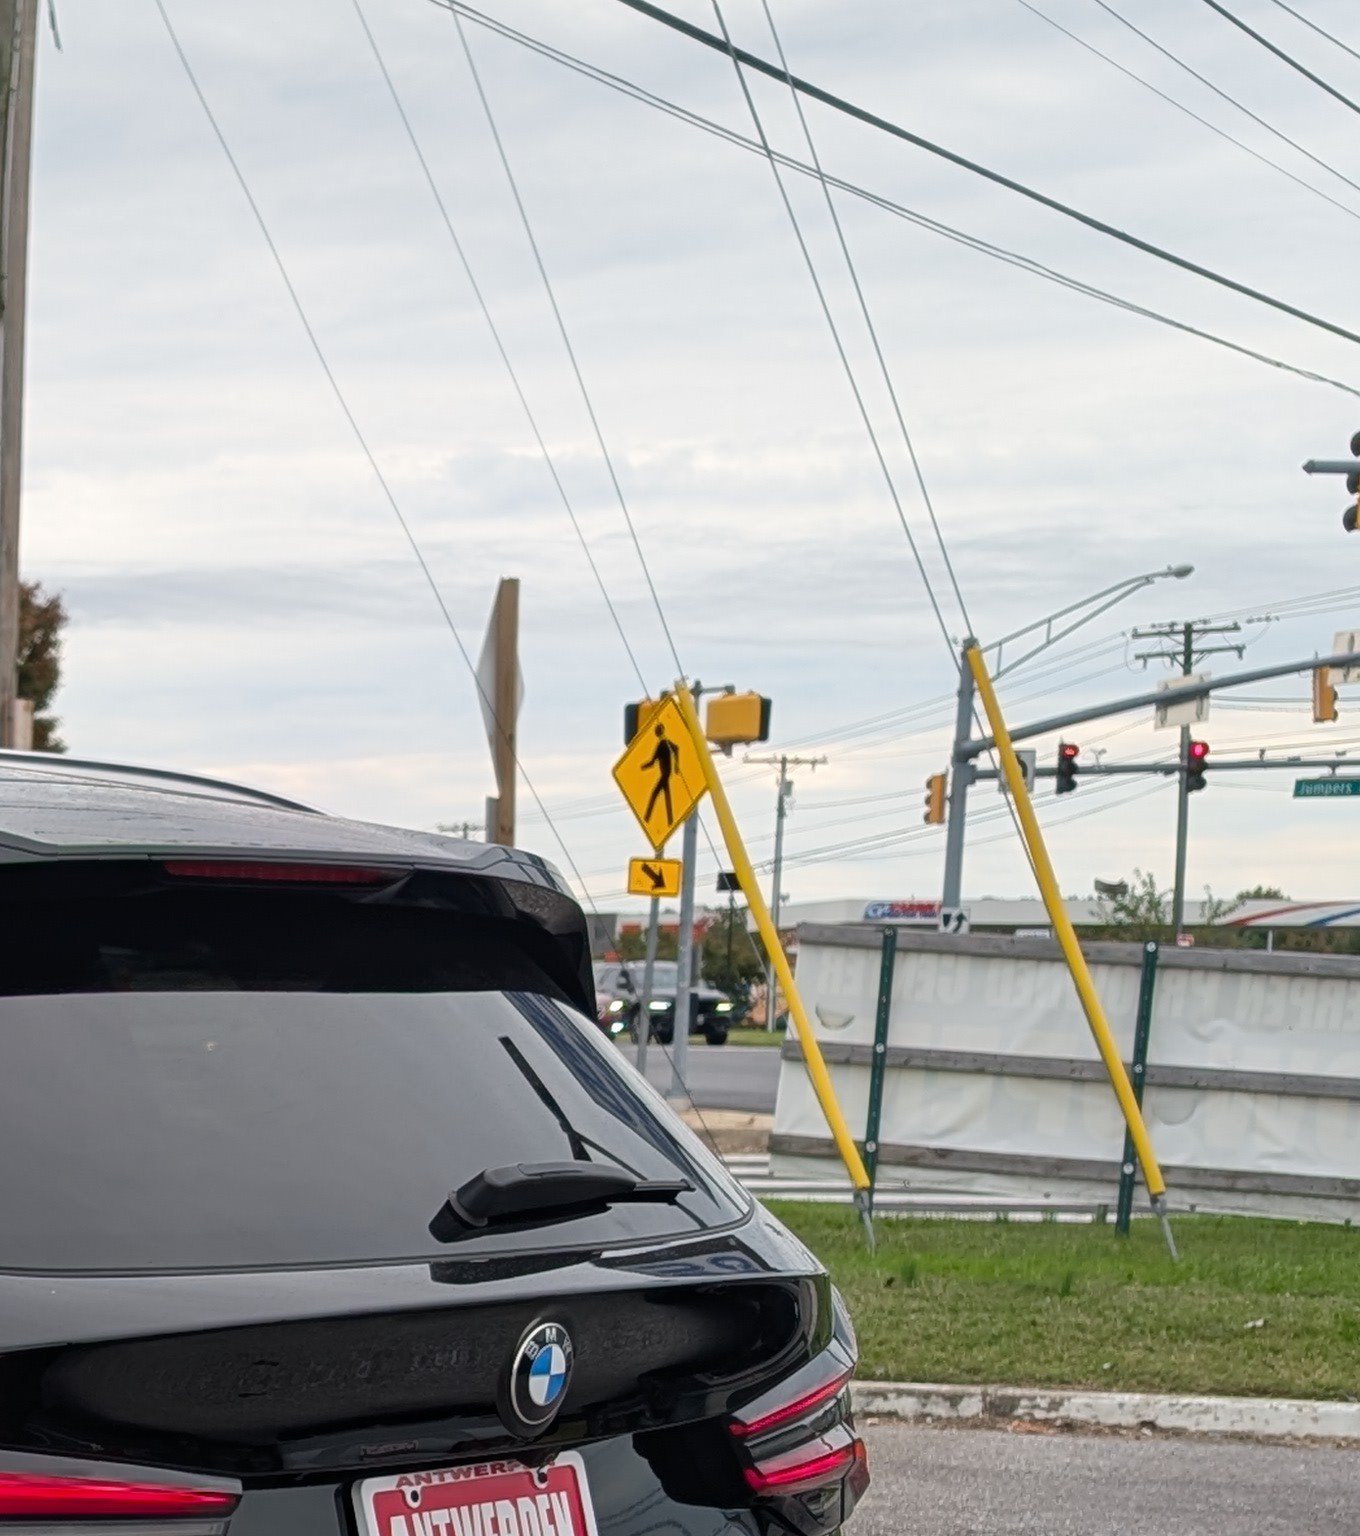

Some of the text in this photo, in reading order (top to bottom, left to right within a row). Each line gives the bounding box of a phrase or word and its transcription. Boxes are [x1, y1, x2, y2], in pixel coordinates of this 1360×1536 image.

[1299, 782, 1353, 795] Jumpers
[524, 1327, 573, 1360] BMW
[396, 1460, 556, 1488] ANTWERP
